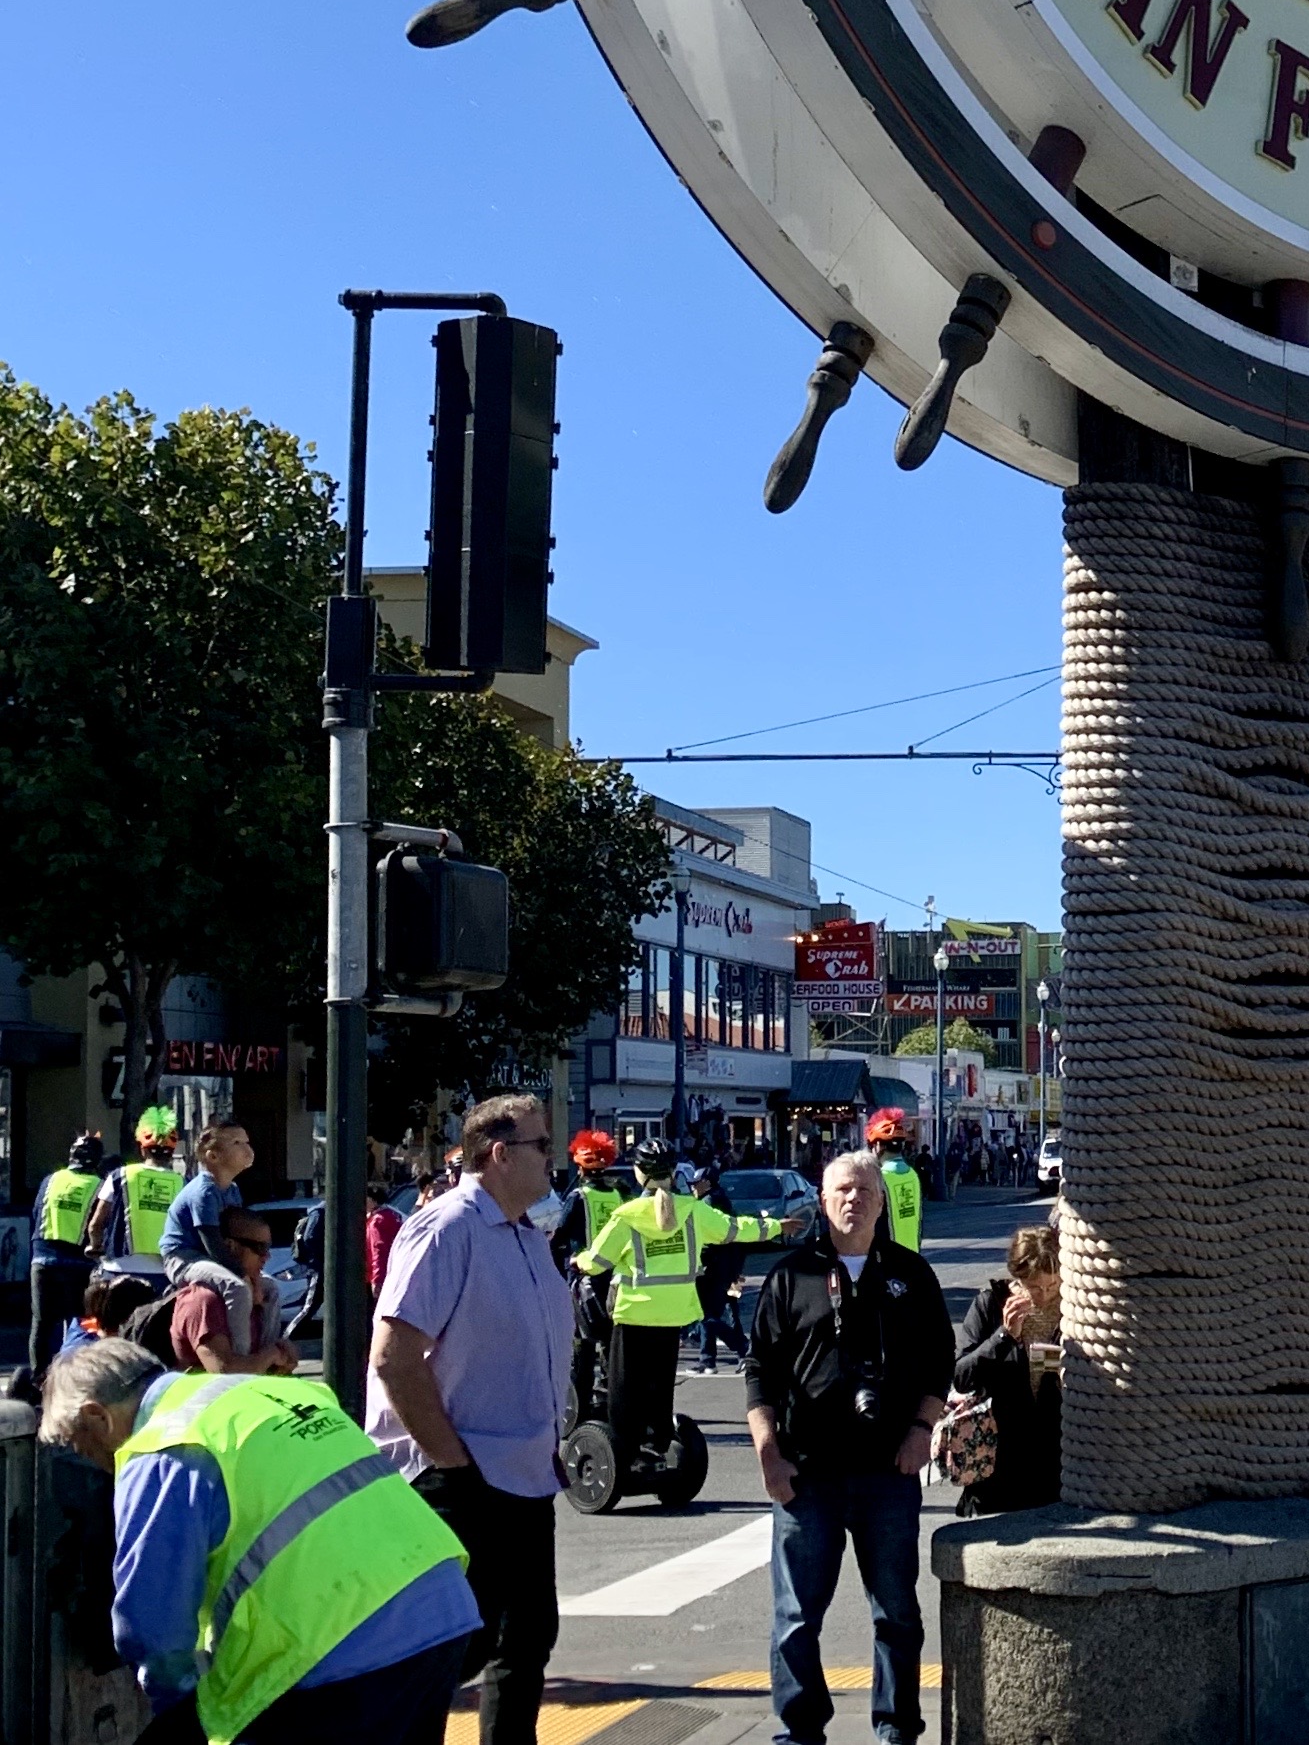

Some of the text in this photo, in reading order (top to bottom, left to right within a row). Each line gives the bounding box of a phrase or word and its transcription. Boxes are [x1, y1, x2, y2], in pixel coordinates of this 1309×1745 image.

[944, 941, 1018, 954] IN-N-OUT
[792, 982, 881, 996] SEAFOOD HOUSE
[811, 1000, 851, 1011] OPEN
